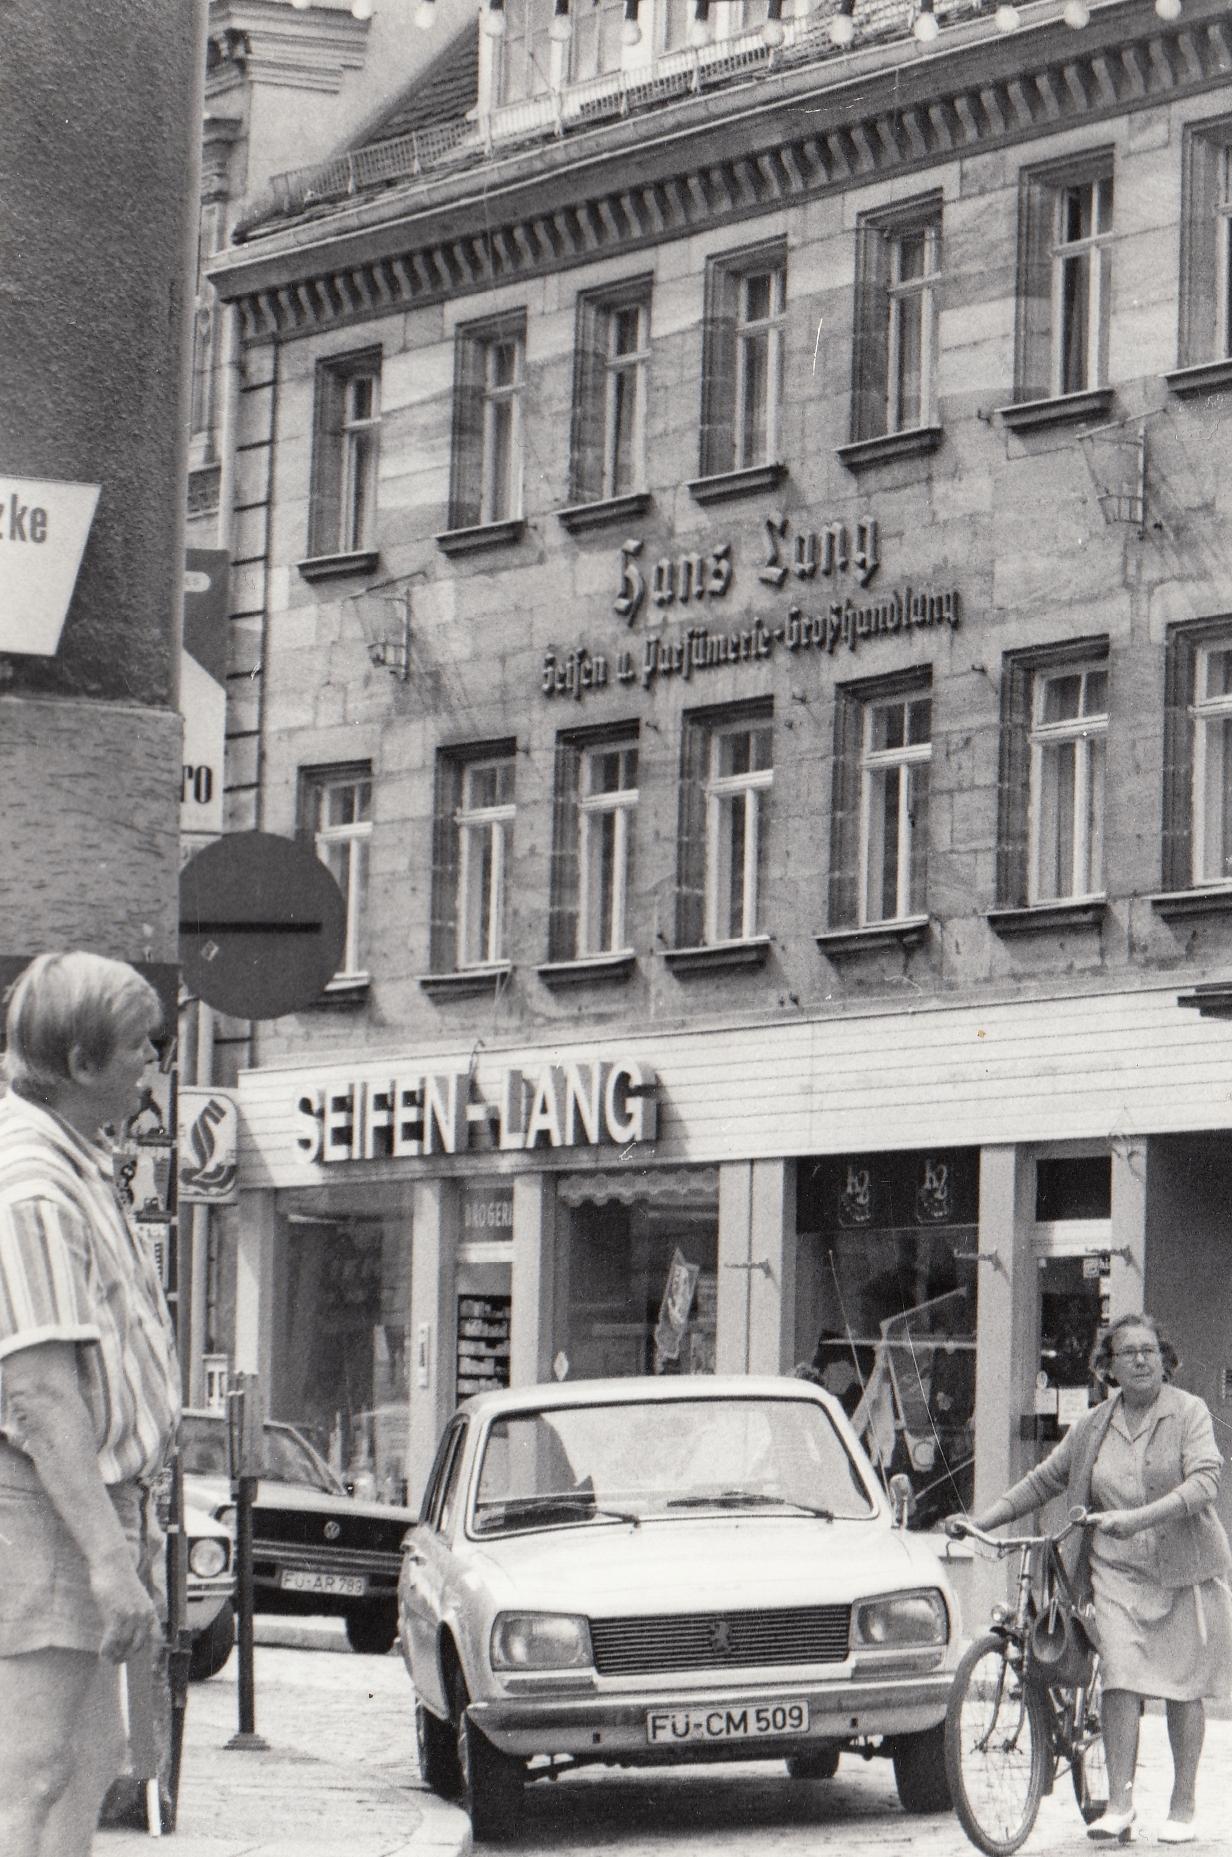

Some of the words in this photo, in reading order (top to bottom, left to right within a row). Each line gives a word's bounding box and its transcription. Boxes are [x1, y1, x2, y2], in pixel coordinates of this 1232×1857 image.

[757, 511, 879, 588] Lang
[296, 1060, 656, 1165] SEIFEN-LANG
[651, 1711, 748, 1739] FÜ-CM
[754, 1704, 804, 1732] 509
